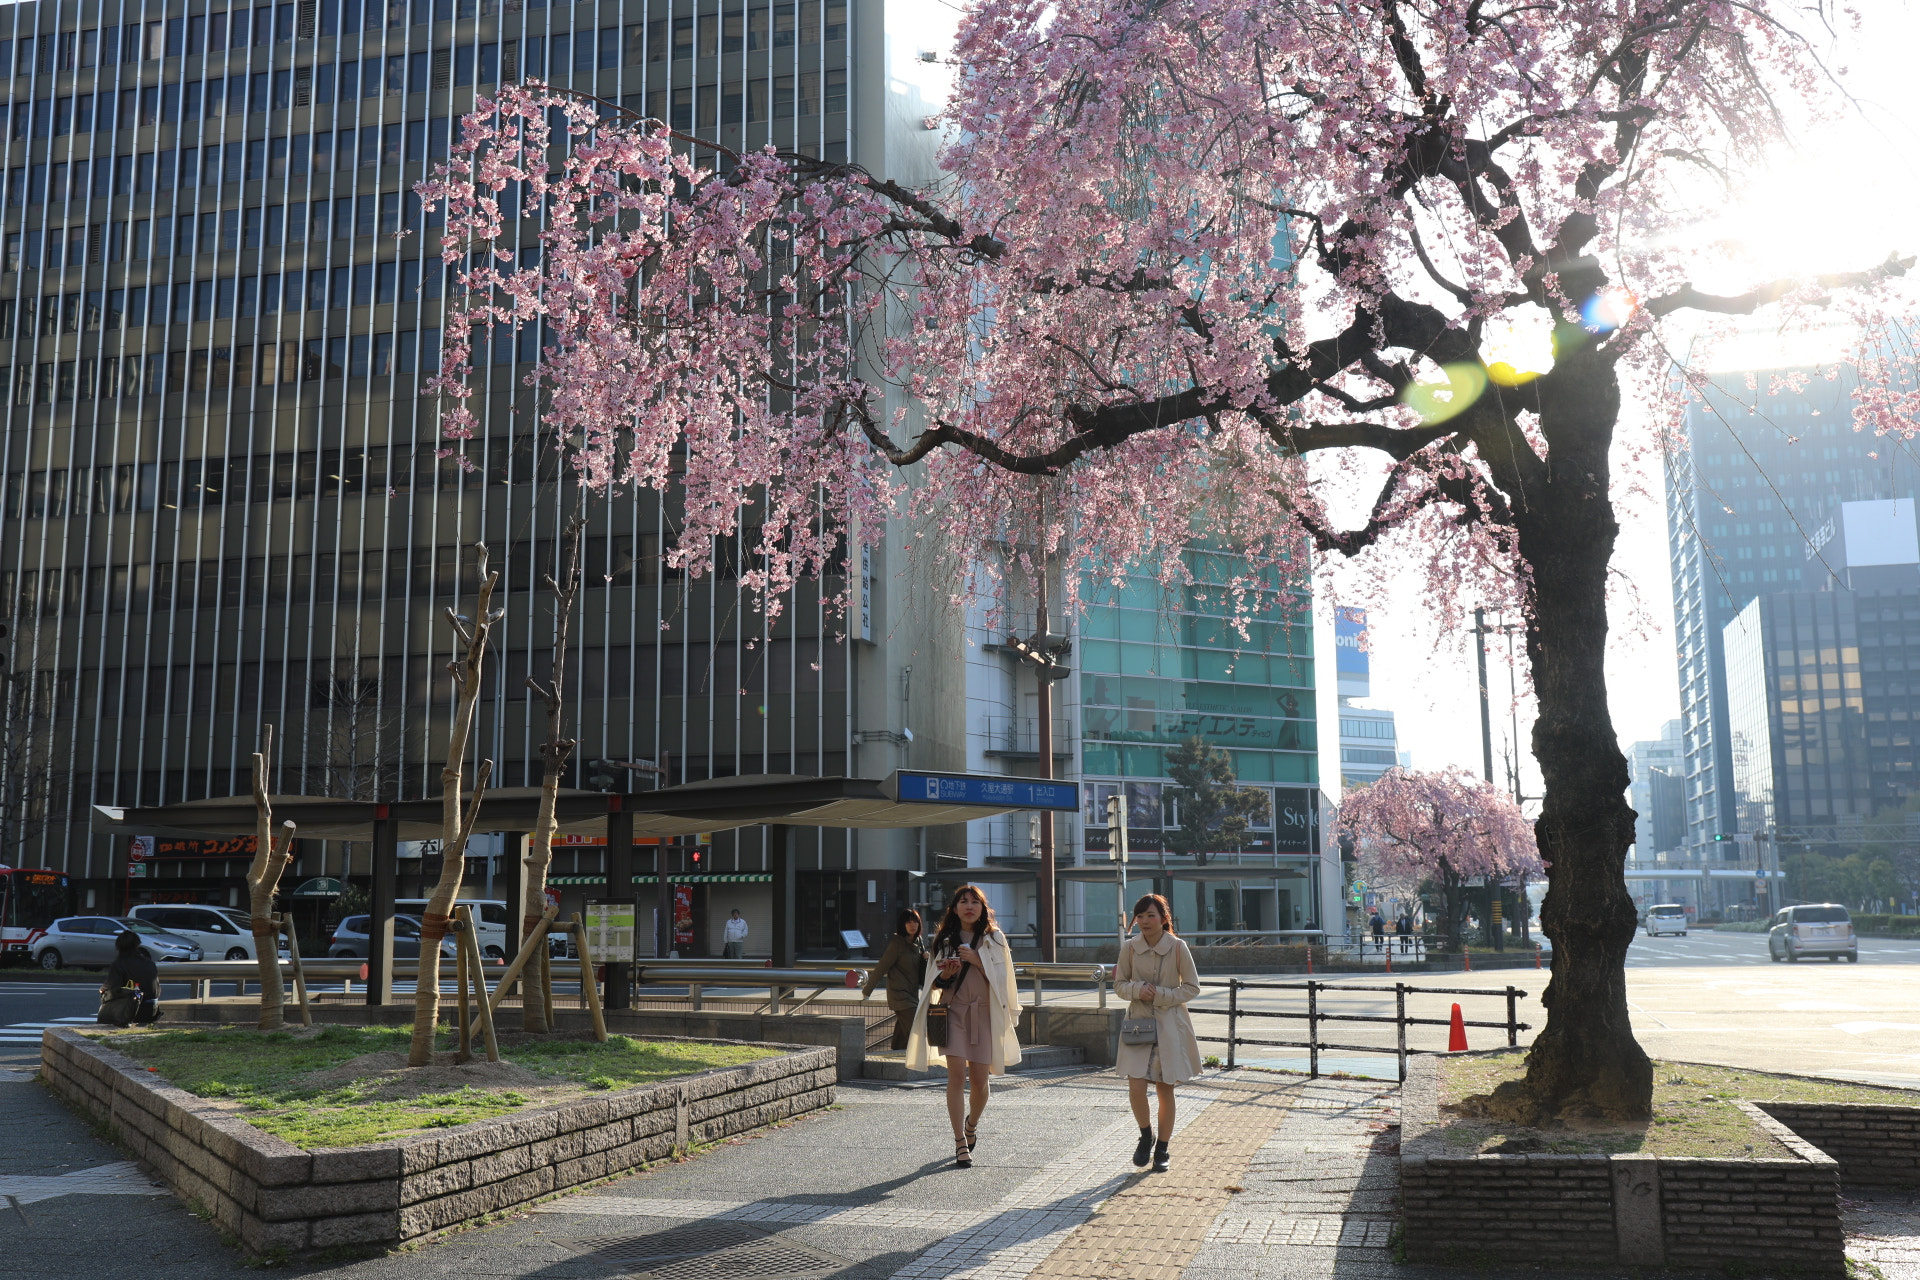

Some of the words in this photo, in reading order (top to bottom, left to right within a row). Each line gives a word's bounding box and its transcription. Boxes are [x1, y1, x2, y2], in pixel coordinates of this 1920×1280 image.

[940, 790, 966, 799] SUBWAY
[948, 780, 966, 791] 地下鉄
[981, 783, 1014, 795] 久屋大通駅
[1028, 785, 1034, 803] 1
[1036, 787, 1055, 797] 出入口
